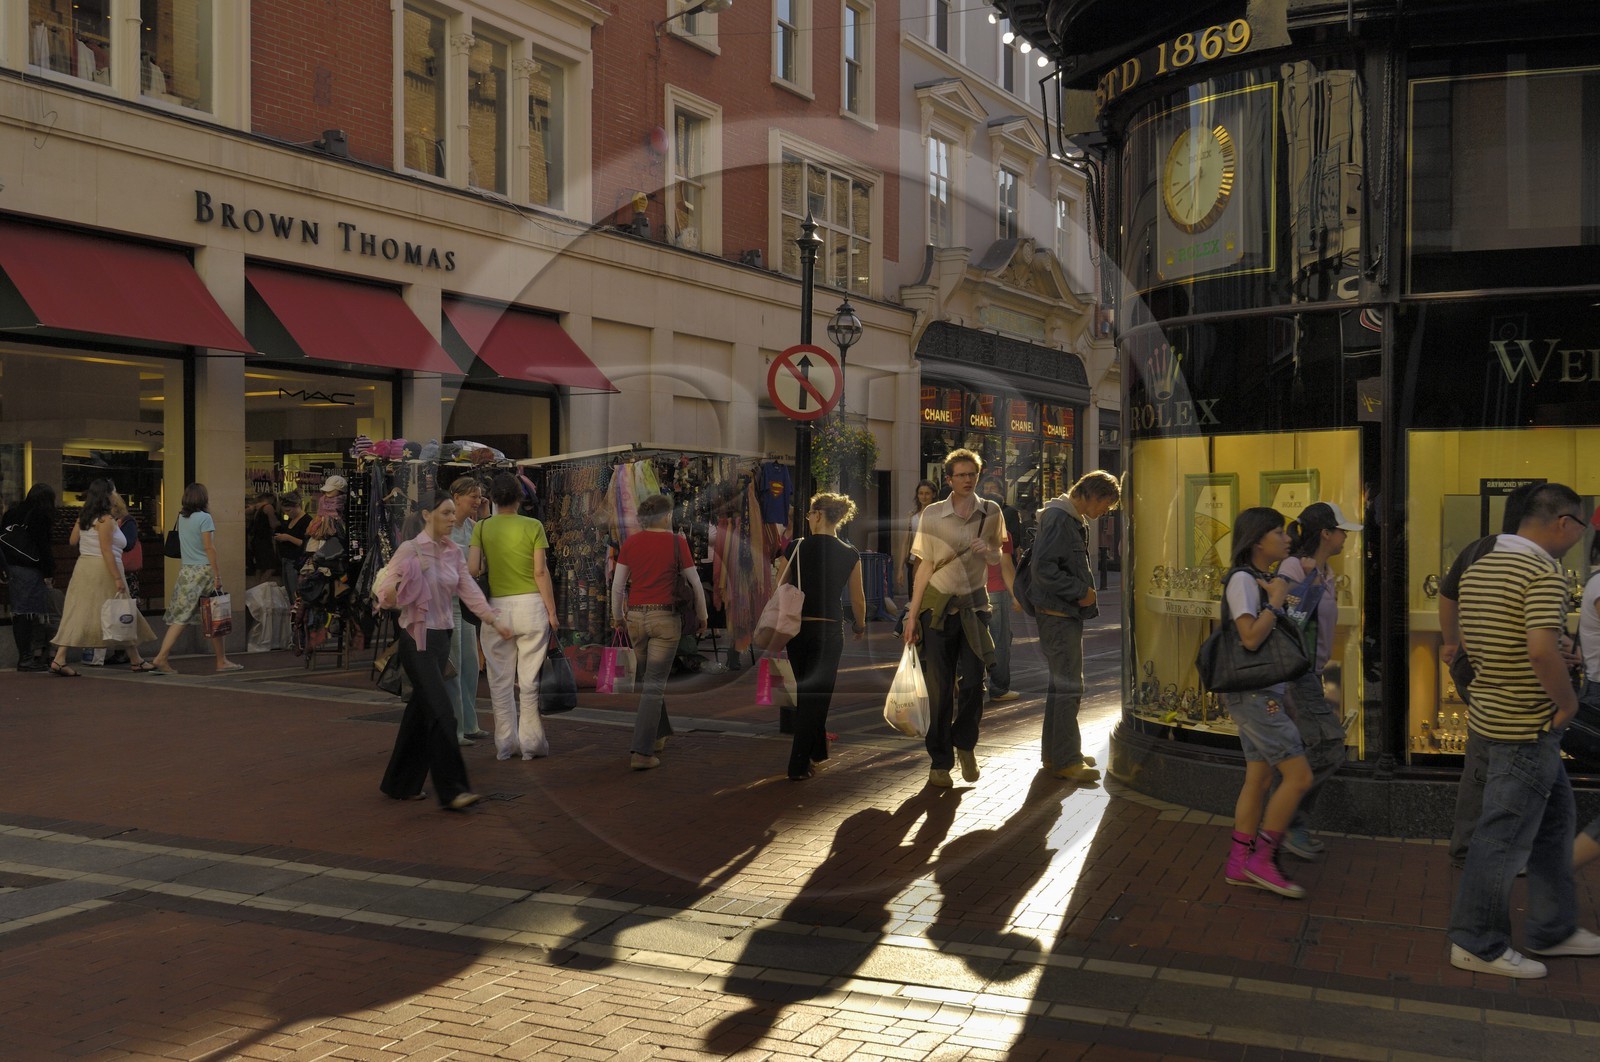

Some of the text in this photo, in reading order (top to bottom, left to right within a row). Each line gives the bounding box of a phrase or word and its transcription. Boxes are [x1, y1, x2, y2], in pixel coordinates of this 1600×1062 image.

[1156, 19, 1251, 75] 1869
[194, 190, 456, 271] BROWN THOMAS
[924, 407, 954, 423] CHANEL
[970, 414, 997, 428] CHANEL
[1130, 398, 1221, 431] ROLEX
[1010, 419, 1035, 433] CHANEL
[1047, 424, 1069, 437] CHANEL
[252, 480, 271, 494] VIVA
